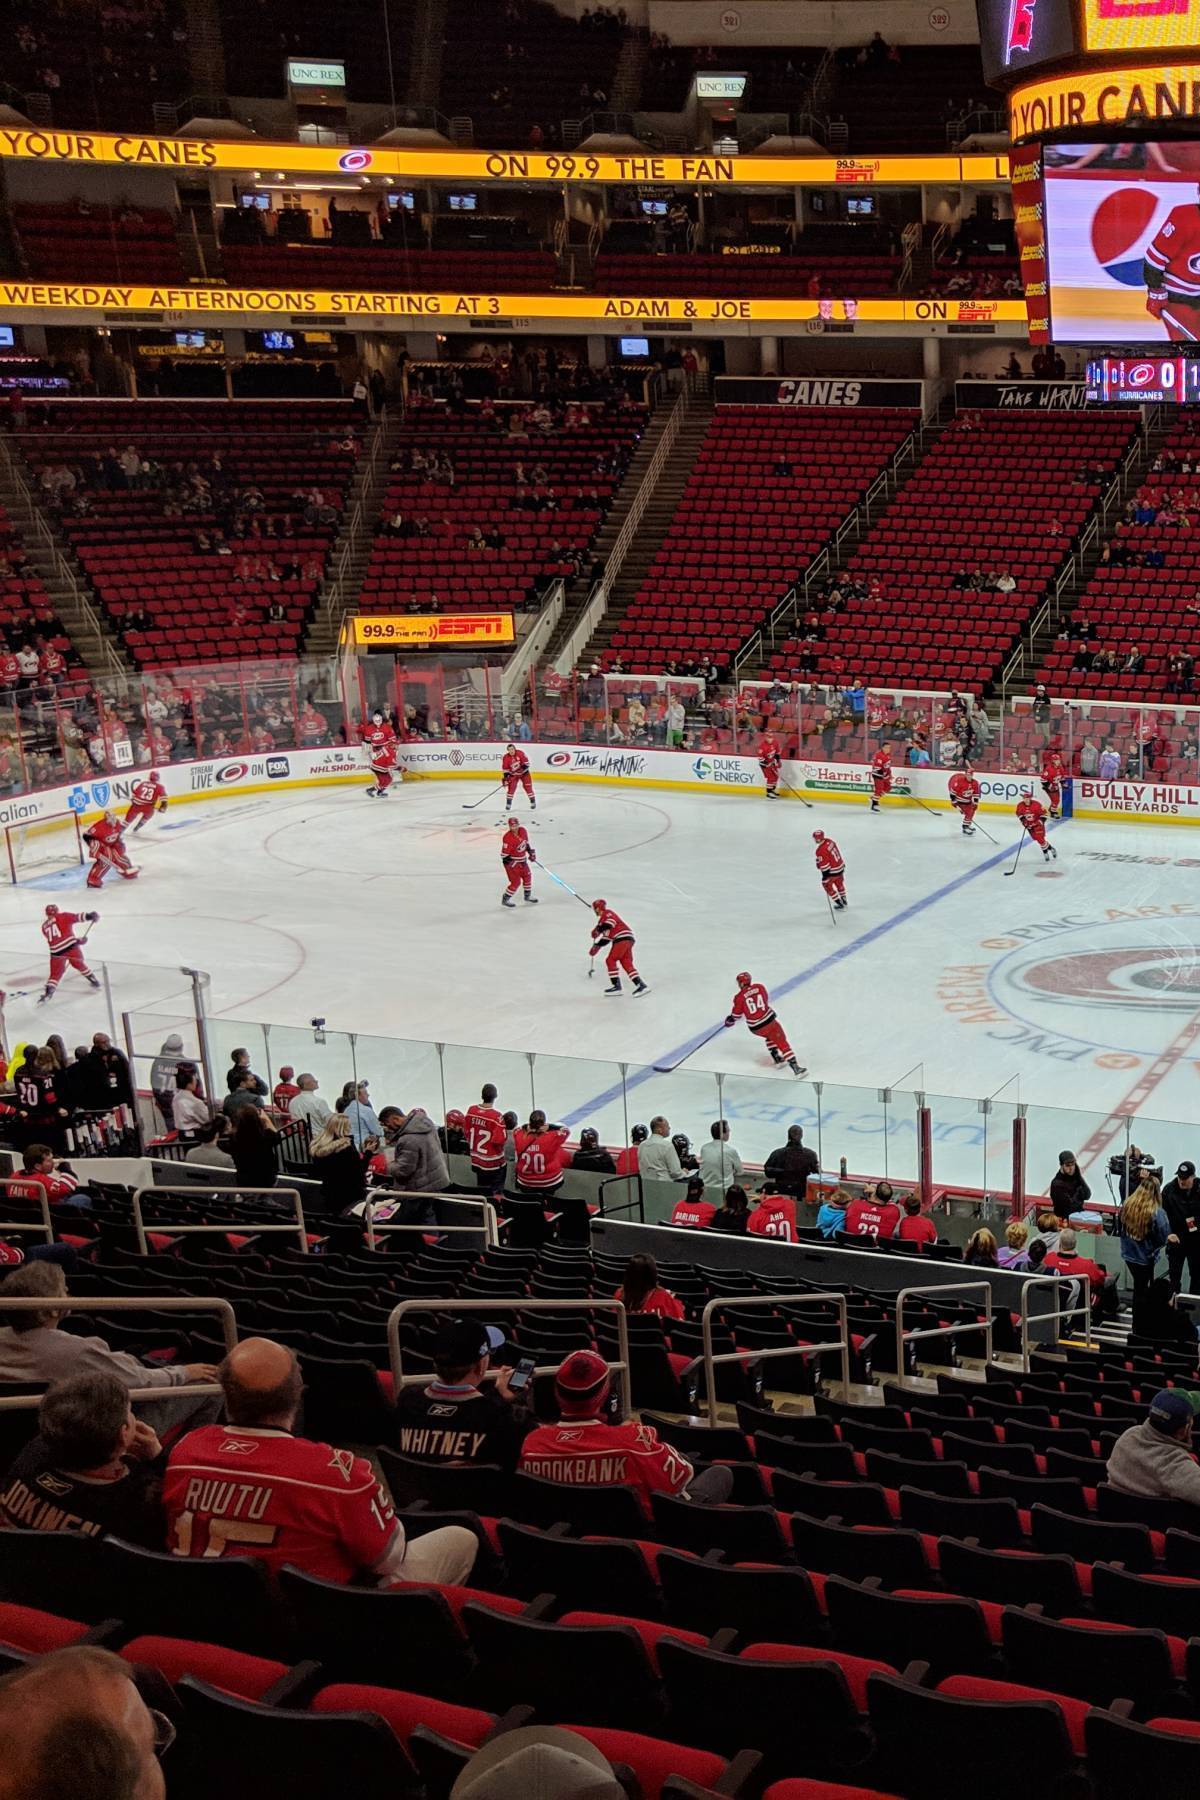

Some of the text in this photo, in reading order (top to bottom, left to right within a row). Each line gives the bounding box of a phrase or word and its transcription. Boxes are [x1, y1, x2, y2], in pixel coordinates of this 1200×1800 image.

[723, 15, 739, 26] 321
[931, 14, 947, 25] 322
[291, 68, 344, 82] UNC REX
[699, 82, 745, 93] UNC REX
[1021, 90, 1087, 134] YOUR
[3, 132, 734, 181] YOUR CANES ON 99.9 THE FAN
[4, 286, 500, 314] WEEKDAY AFTERNOONS STARTING AT 3
[604, 300, 947, 319] ADAM & JOE ON
[1161, 362, 1175, 388] 0
[777, 381, 862, 406] CANES
[997, 386, 1032, 407] TAKE
[363, 624, 394, 638] 99.9
[438, 617, 502, 635] ESPN
[268, 760, 288, 772] FOX
[402, 753, 503, 763] VECTOR SECUR
[572, 750, 648, 778] TAKE WARNING
[713, 759, 741, 772] DUKE
[190, 764, 213, 775] STREAM
[251, 763, 264, 777] ON
[713, 770, 755, 784] ENERGY
[818, 768, 862, 782] Harris
[191, 773, 213, 790] LIVE
[978, 781, 1034, 800] pepsi
[141, 786, 156, 801] 23
[1081, 782, 1199, 806] BULLY HILL
[1101, 799, 1179, 815] VINEYARDS
[45, 925, 62, 942] 74
[1006, 914, 1099, 940] PNC
[746, 994, 765, 1014] 64
[935, 962, 1094, 1062] PNC ARENA
[704, 1098, 987, 1146] UNC REX
[470, 1127, 492, 1154] 12
[521, 1153, 545, 1174] 20
[675, 1210, 700, 1223] DARLING
[769, 1212, 784, 1222] AHO
[400, 1428, 487, 1457] WHITNEY
[187, 1478, 273, 1520] RUUTU
